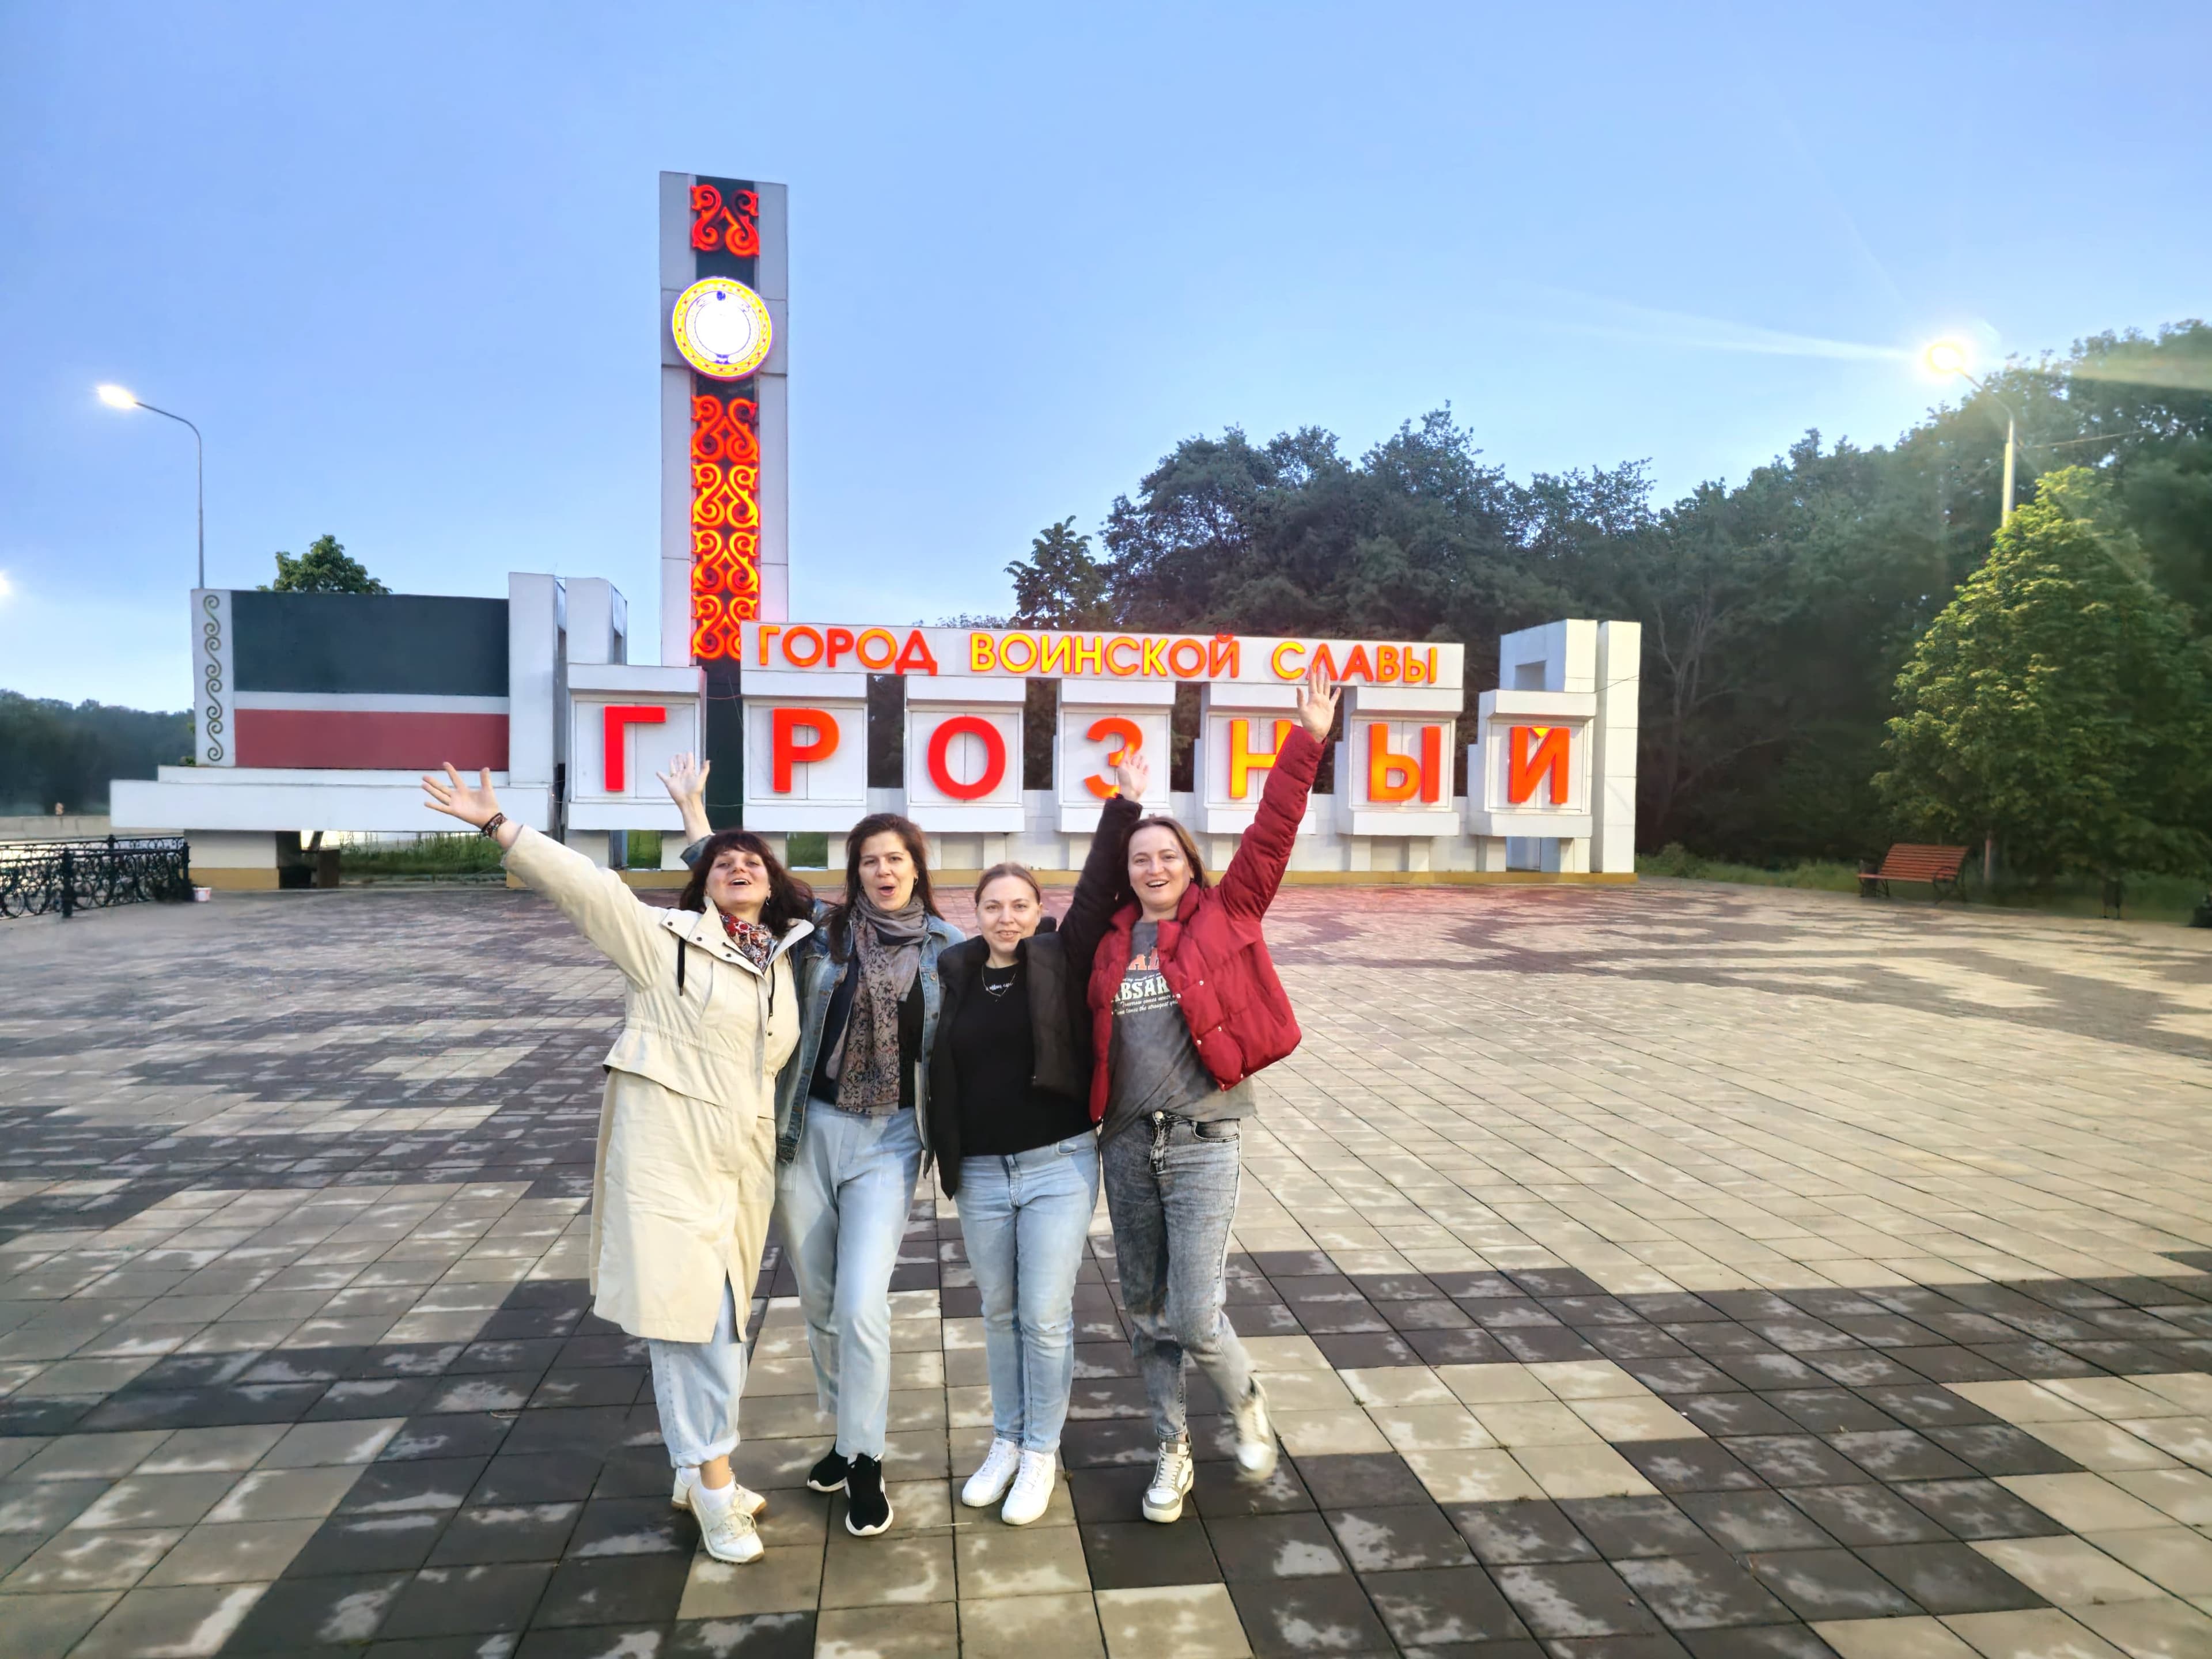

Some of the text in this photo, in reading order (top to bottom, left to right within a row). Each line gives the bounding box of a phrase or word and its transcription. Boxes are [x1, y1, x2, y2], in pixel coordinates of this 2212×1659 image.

[758, 625, 1438, 684] ГОРОД ВОИНСКОЙ СЛАВЫ
[603, 705, 1571, 804] ГРОЗНЫЙ
